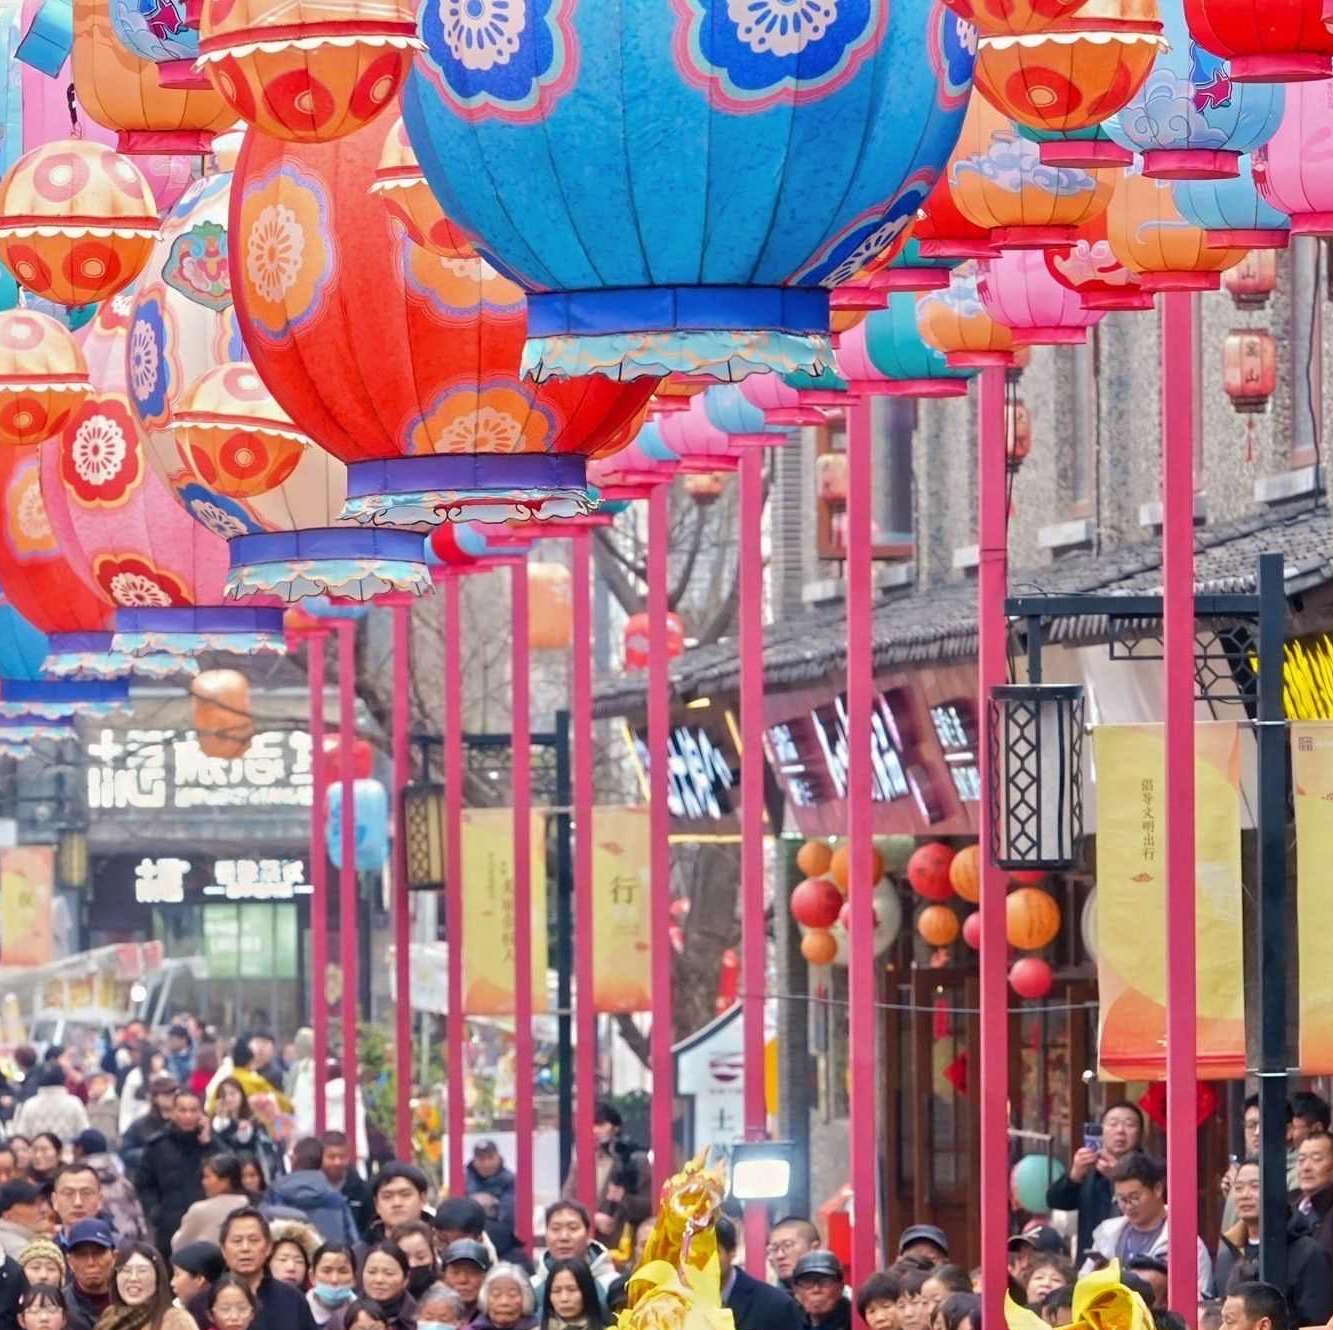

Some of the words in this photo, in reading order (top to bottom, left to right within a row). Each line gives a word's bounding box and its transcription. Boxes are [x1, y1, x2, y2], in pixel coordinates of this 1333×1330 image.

[1141, 778, 1155, 861] 倡导文明出行
[610, 876, 638, 905] 行
